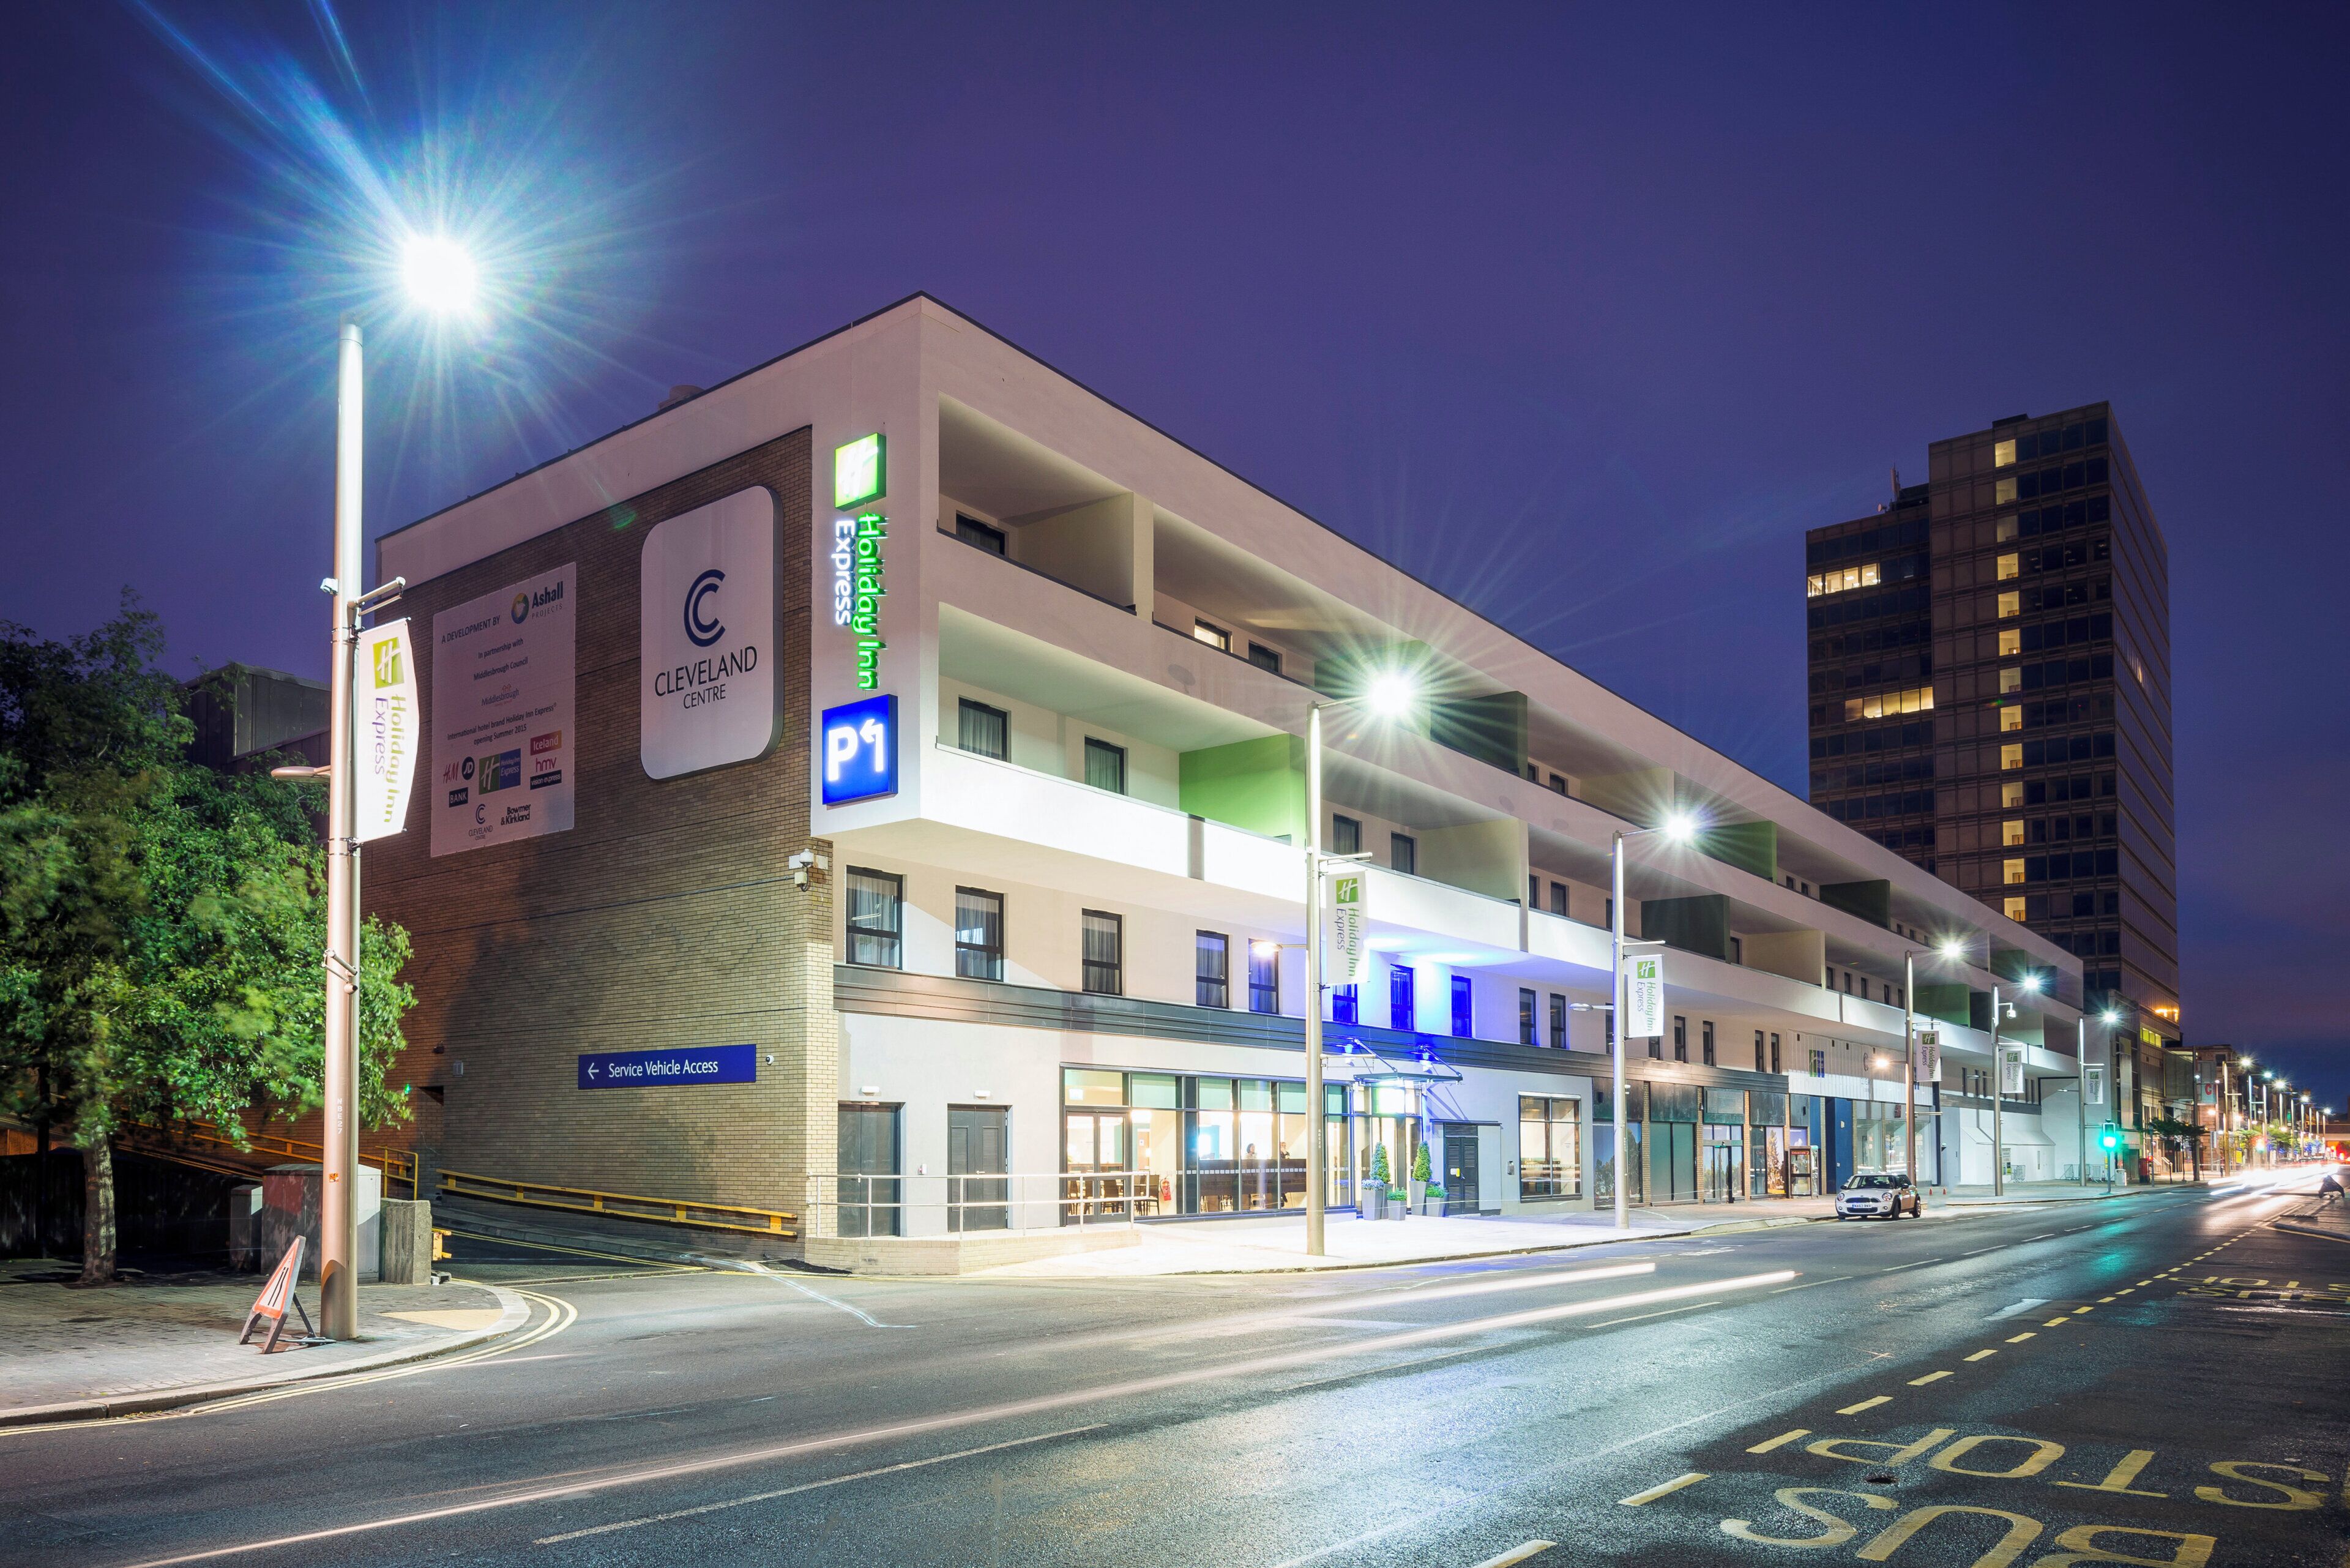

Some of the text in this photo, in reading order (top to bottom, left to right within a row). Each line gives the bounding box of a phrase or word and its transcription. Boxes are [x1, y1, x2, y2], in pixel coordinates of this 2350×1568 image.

[831, 520, 856, 625] Express
[532, 581, 564, 609] Ashall
[852, 512, 881, 690] Holiday Inn
[531, 603, 562, 619] PROJECTS
[441, 614, 501, 644] A DEVELOPMENT BY
[478, 638, 524, 660] In partnership with
[474, 657, 528, 681] Middlesbrough Council
[655, 646, 758, 697] CLEVELAND
[481, 688, 520, 706] Middlesbrough
[684, 684, 726, 709] CENTRE
[371, 697, 389, 775] Express
[447, 725, 477, 741] International
[478, 722, 490, 731] hotel
[491, 717, 505, 728] brand
[506, 713, 525, 725] Holiday
[474, 723, 527, 746] opening Summer 2015
[533, 735, 559, 751] Iceland
[827, 728, 858, 782] P
[384, 694, 406, 823] Holiday Inn
[463, 761, 474, 775] JD
[535, 756, 557, 773] hmv
[442, 761, 459, 784] H&M
[501, 766, 520, 777] Express
[531, 773, 561, 786] vision express
[450, 790, 467, 804] BANK
[507, 804, 532, 816] Bowmer
[468, 825, 493, 837] CLEVELAND
[1334, 908, 1346, 950] Express
[1346, 908, 1360, 977] Holiday Inn
[1636, 982, 1645, 1012] Express
[1645, 981, 1656, 1031] Holiday Inn
[608, 1059, 718, 1077] Service Vehicle Access
[1805, 1428, 2330, 1510] STOP
